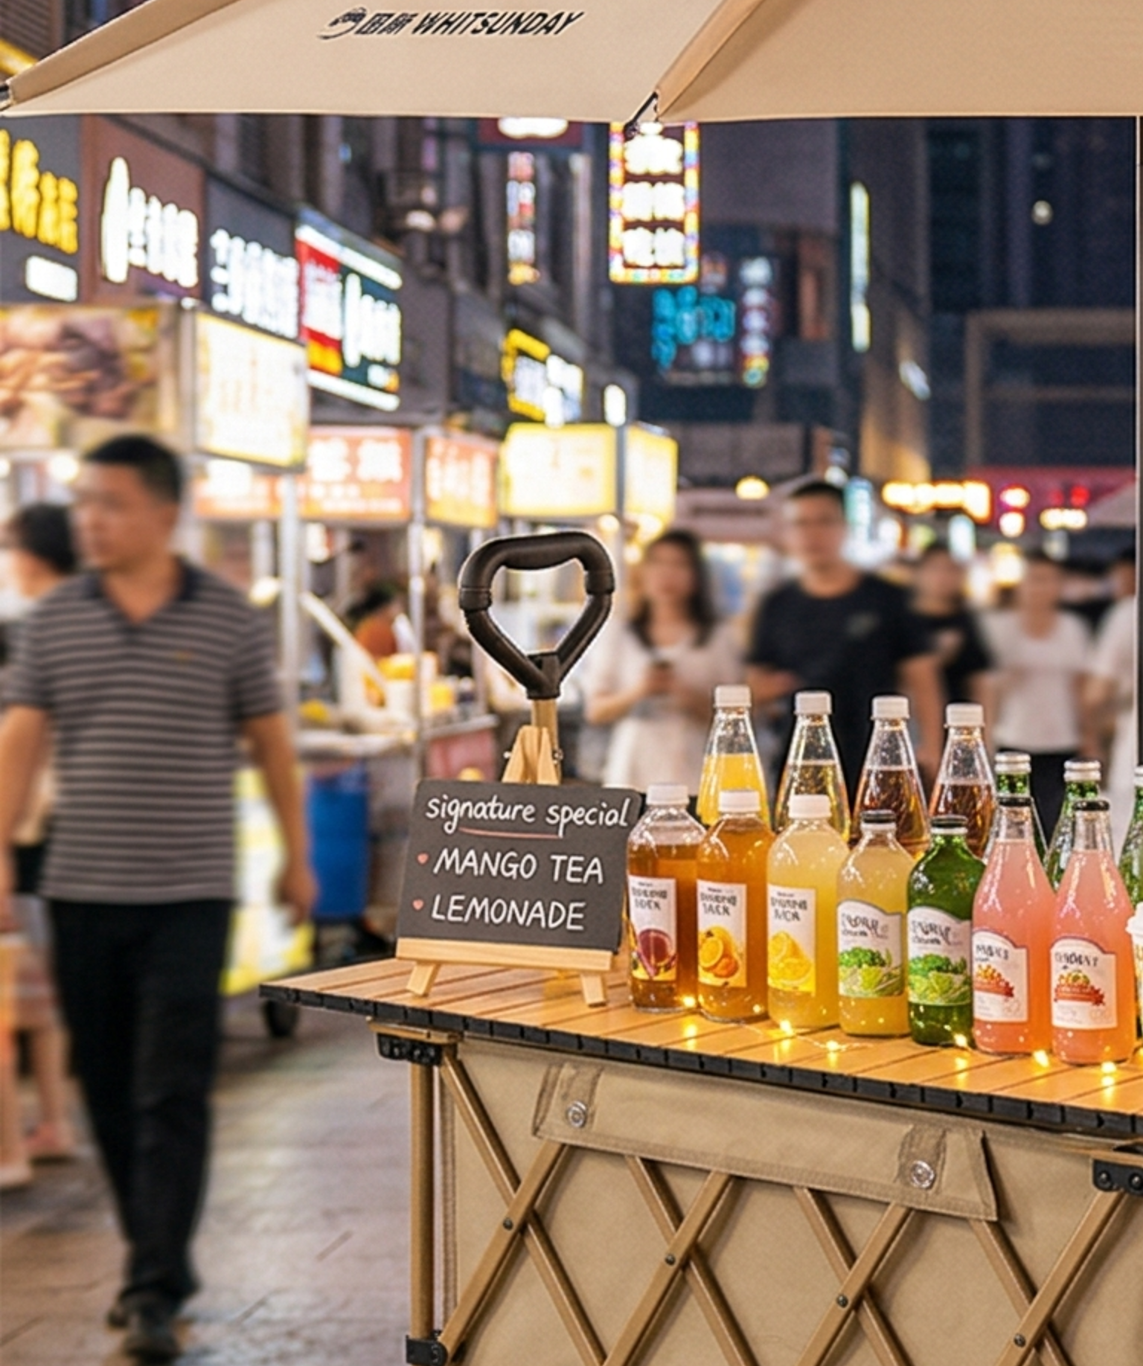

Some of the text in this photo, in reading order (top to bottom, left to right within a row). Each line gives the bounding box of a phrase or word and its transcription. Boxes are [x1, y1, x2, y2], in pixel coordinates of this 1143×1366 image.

[411, 11, 585, 35] WHITSUNDAY
[426, 794, 630, 838] signature special
[434, 848, 602, 883] MANGO TEA
[432, 895, 585, 930] LEMONADE
